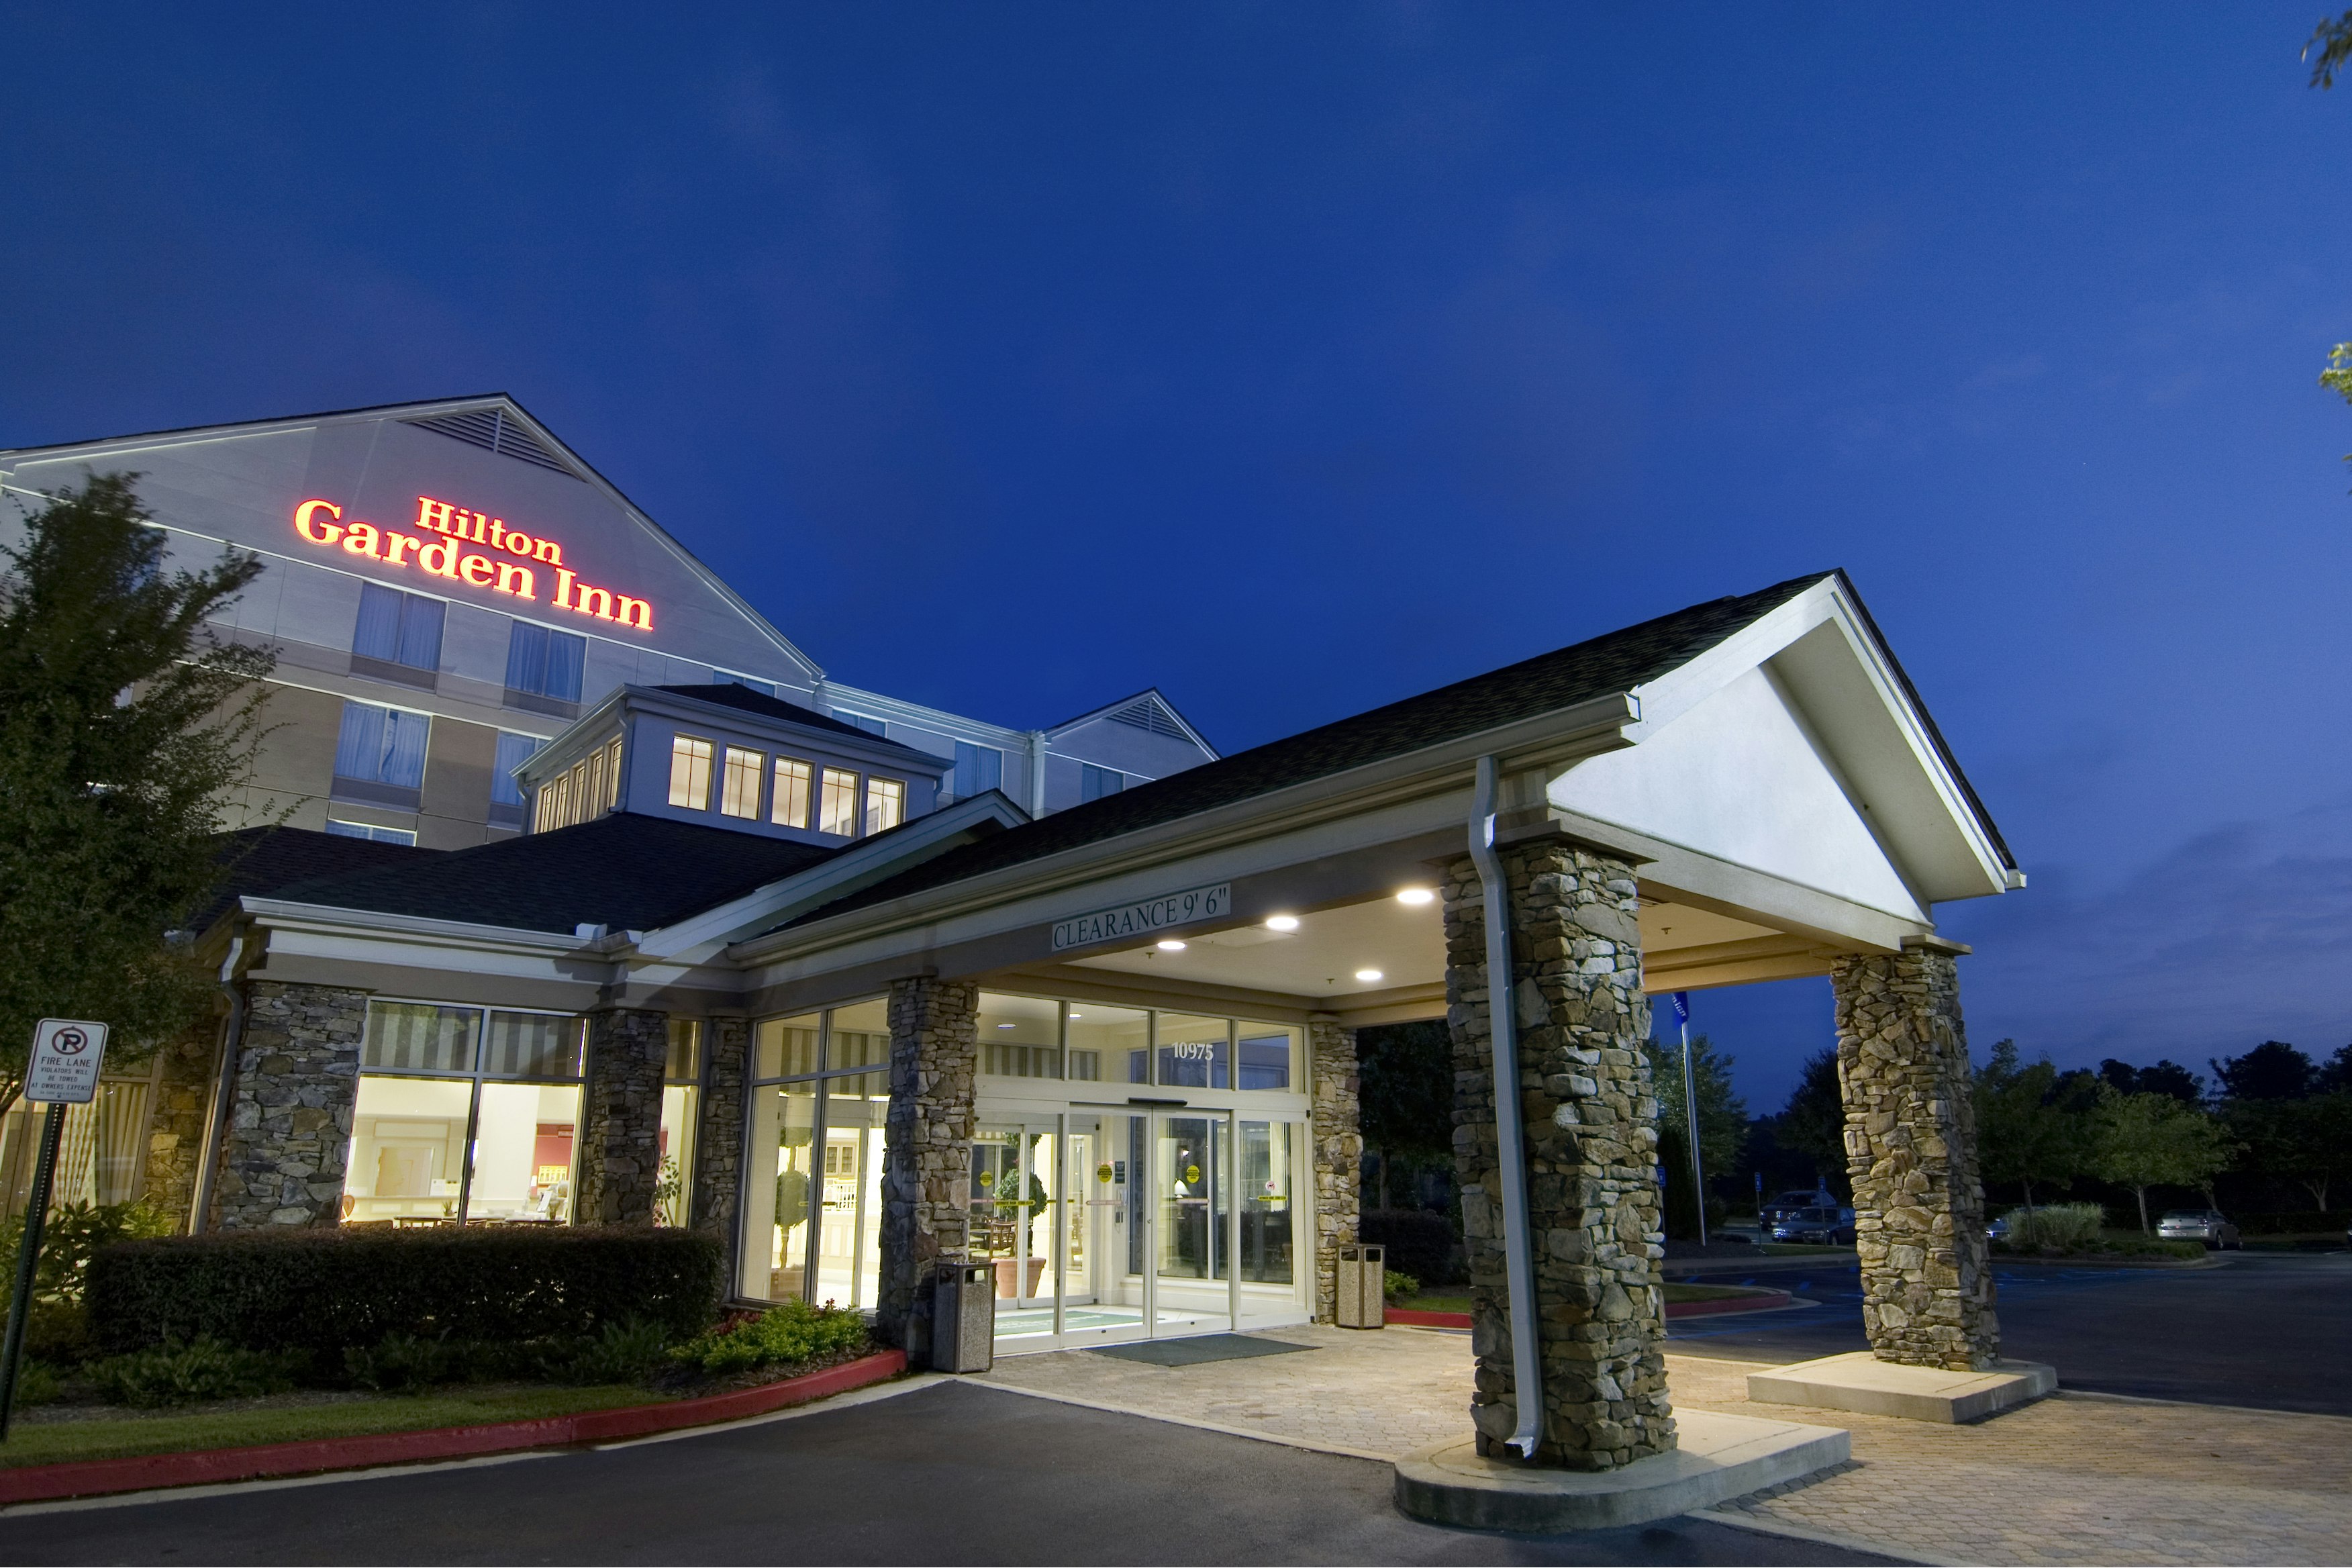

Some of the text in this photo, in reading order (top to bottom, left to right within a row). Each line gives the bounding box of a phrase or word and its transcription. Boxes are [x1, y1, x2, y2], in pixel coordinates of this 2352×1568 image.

[415, 496, 563, 567] Hilton
[293, 498, 654, 632] Garden Inn
[1053, 898, 1178, 948] CLEARANCE
[1183, 893, 1199, 920] 9'
[40, 1057, 91, 1067] FIRE LANE
[1171, 1042, 1214, 1061] 10975
